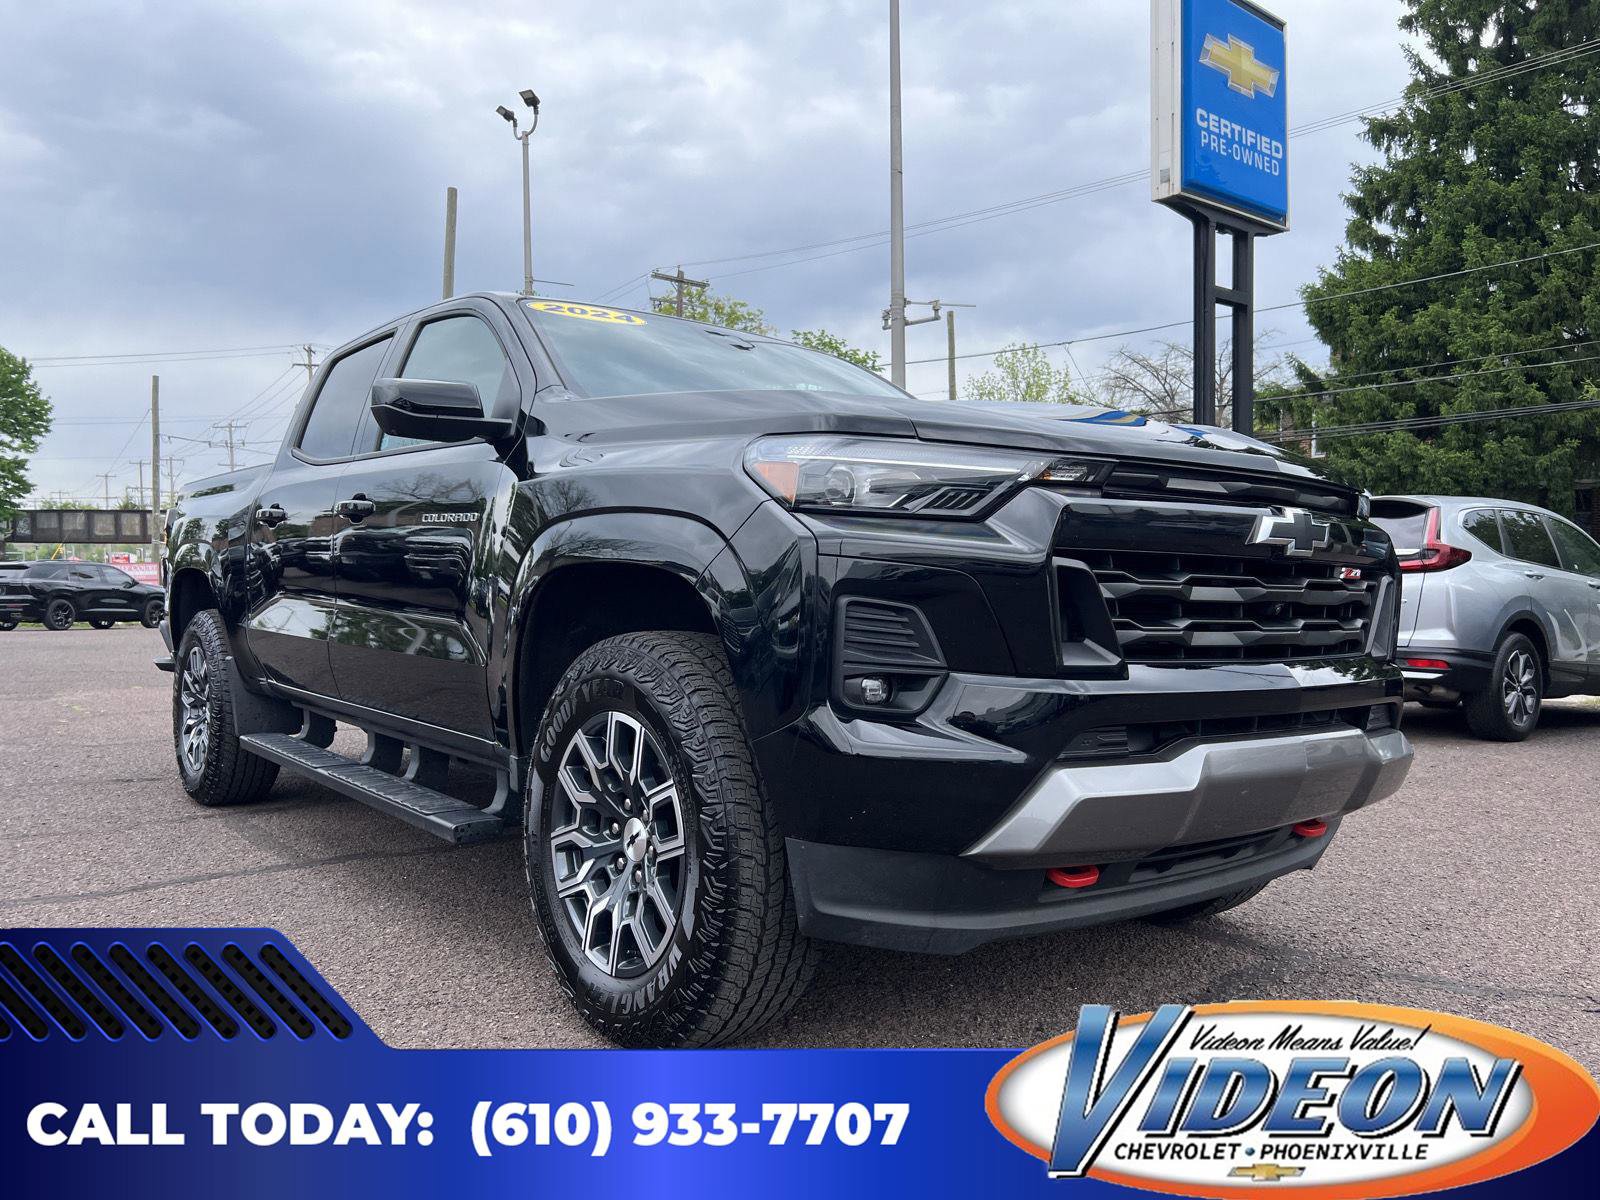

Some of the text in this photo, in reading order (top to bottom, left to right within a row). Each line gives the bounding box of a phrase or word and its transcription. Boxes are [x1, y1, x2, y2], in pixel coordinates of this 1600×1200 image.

[1196, 108, 1283, 159] CERTIFIED
[1201, 131, 1280, 176] PRE-OWNED
[544, 303, 634, 322] 2024
[421, 512, 480, 523] COLORADO
